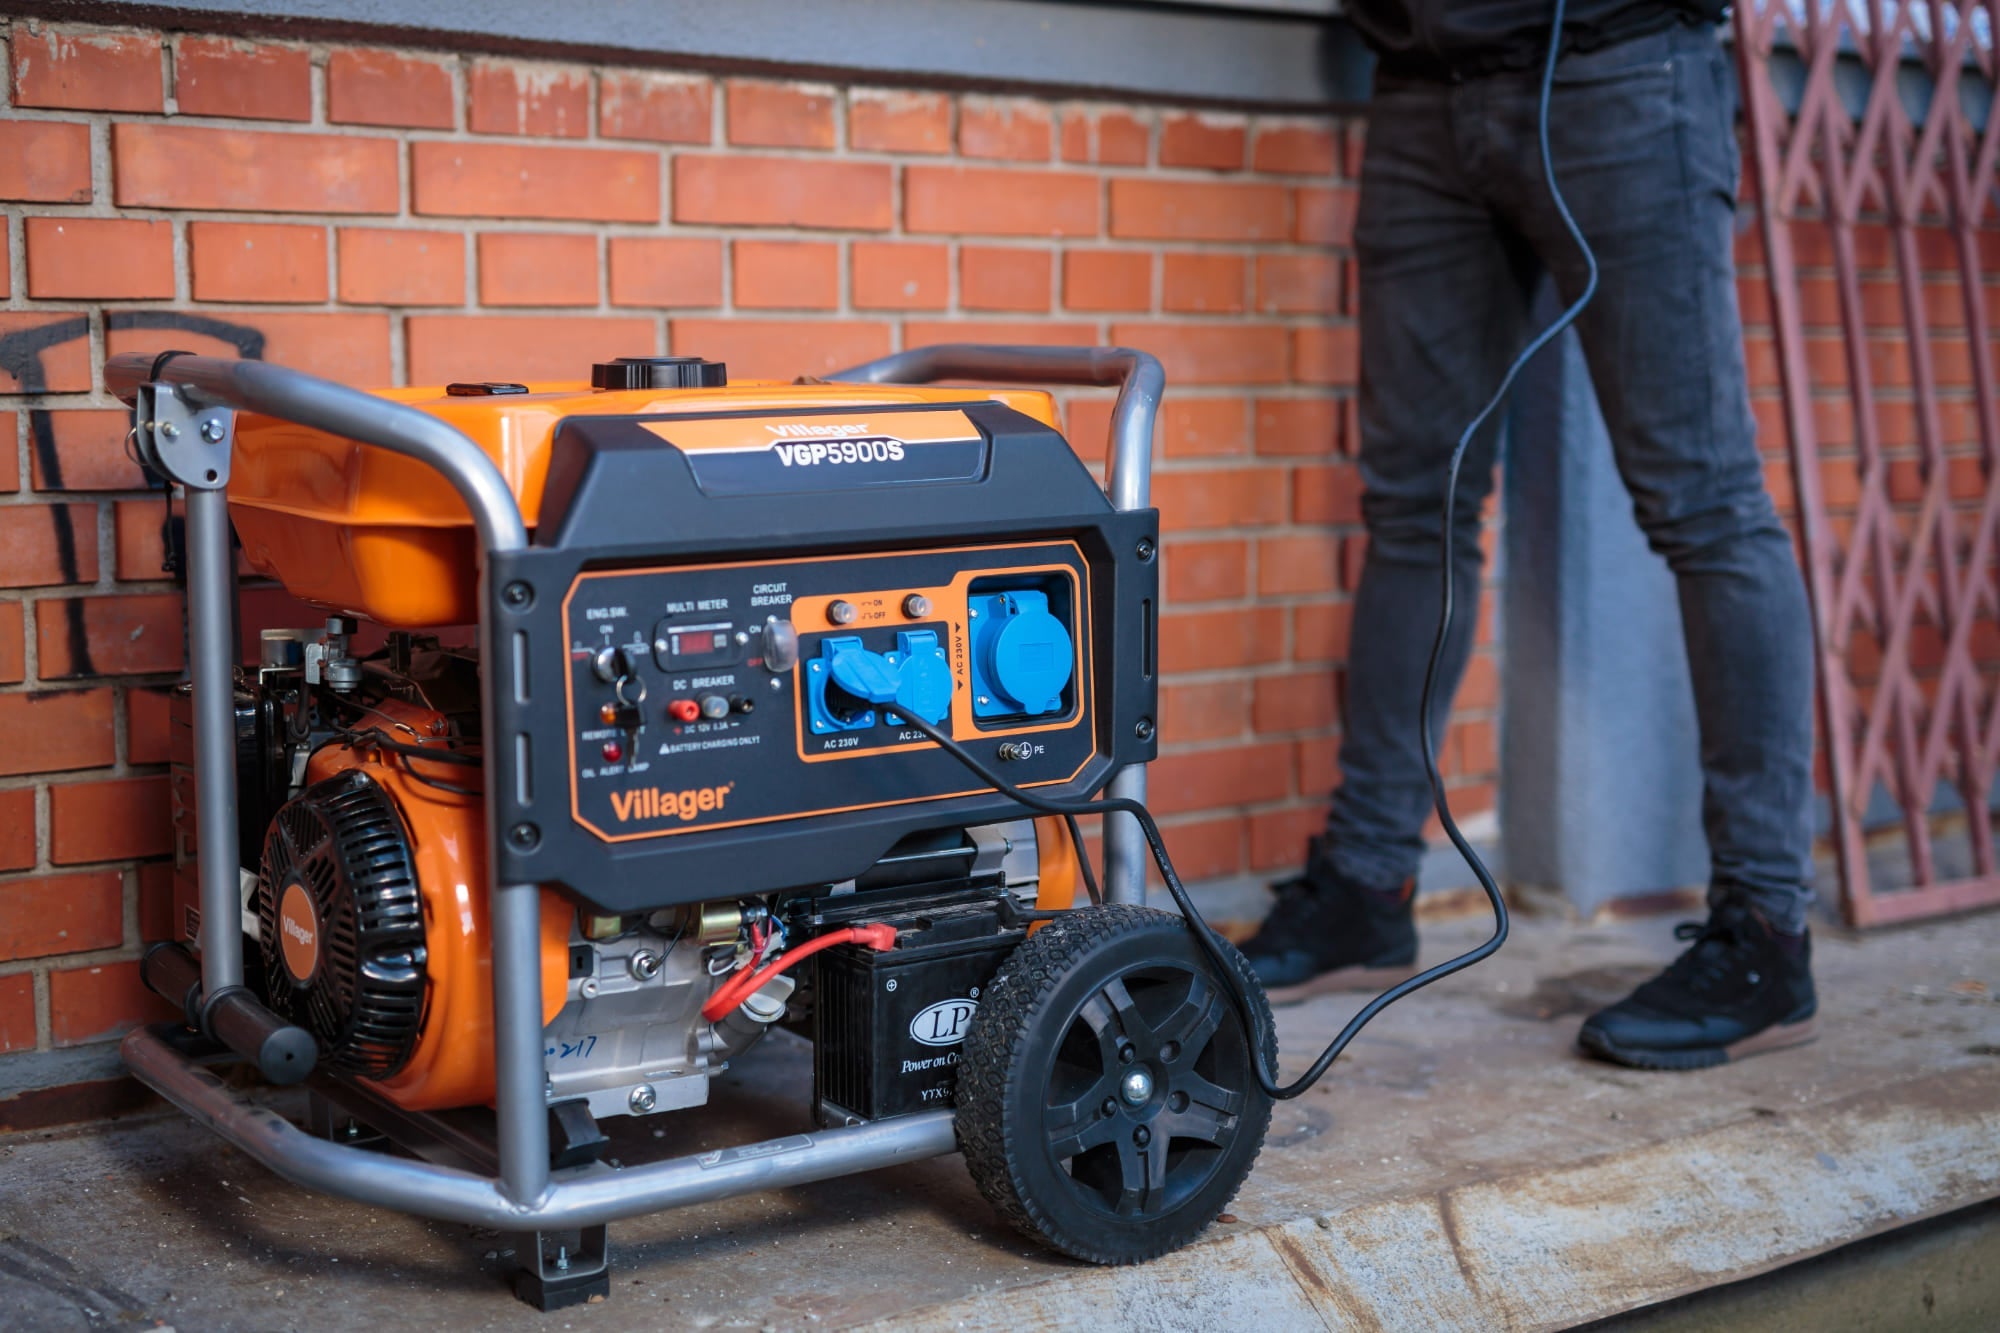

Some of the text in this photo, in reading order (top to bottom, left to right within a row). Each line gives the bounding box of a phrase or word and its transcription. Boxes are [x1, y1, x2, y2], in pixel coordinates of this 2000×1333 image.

[764, 423, 869, 437] Villager
[774, 440, 905, 467] VGP5900S
[753, 582, 787, 594] CIRCUIT
[666, 599, 729, 613] MULTI METER
[751, 594, 792, 607] BREAKER
[749, 625, 762, 634] ON
[955, 636, 963, 675] AC 230V
[673, 675, 735, 691] DC BREAKER
[899, 731, 911, 741] AC
[824, 737, 859, 750] AC 230V
[1034, 745, 1045, 755] PE
[609, 785, 731, 822] Villager
[283, 914, 314, 945] Villager
[930, 1006, 970, 1040] LP
[901, 1058, 933, 1074] Power
[933, 1056, 946, 1068] on
[921, 1087, 953, 1101] YTX9
